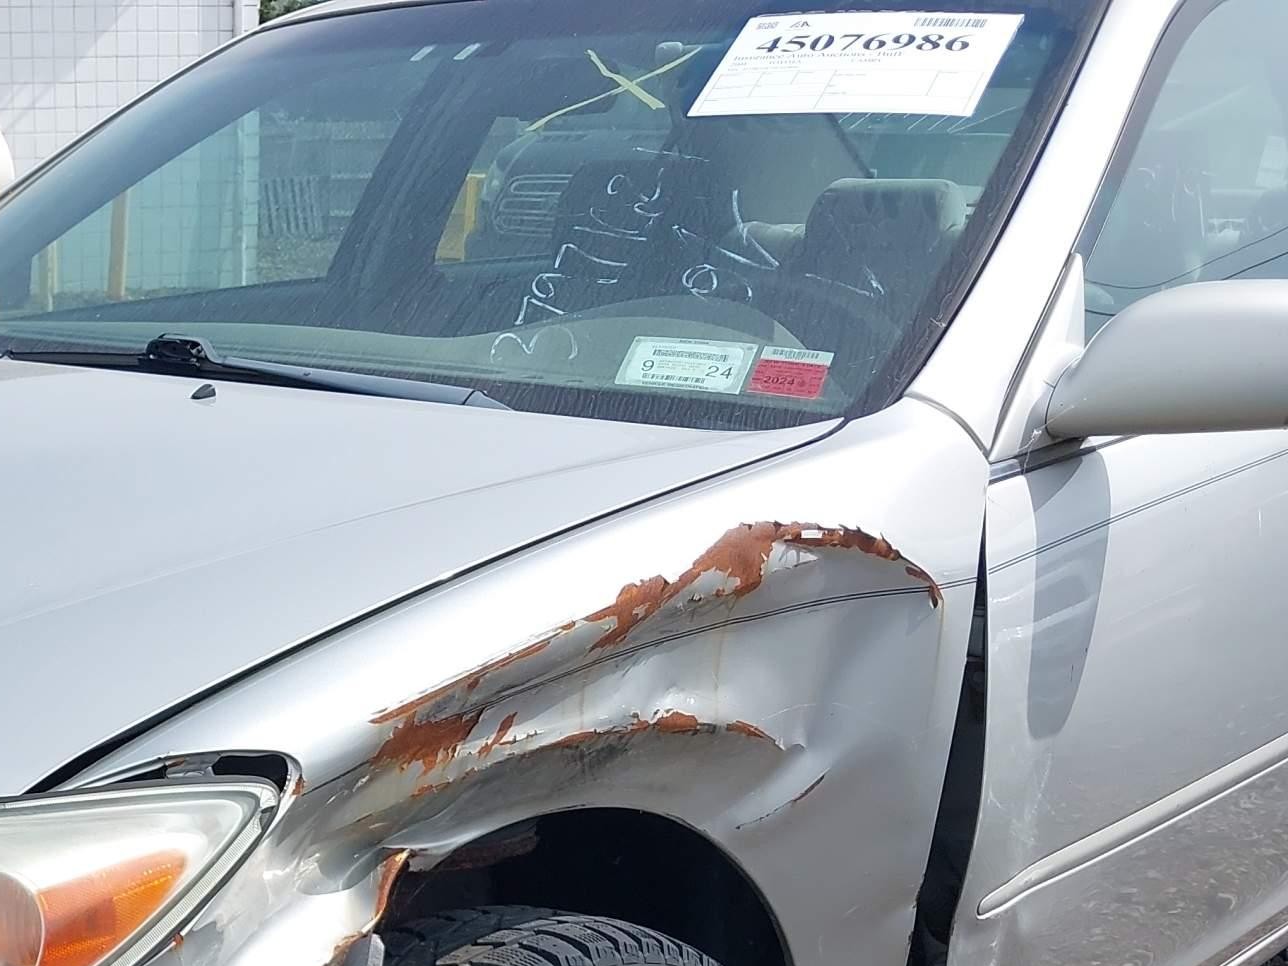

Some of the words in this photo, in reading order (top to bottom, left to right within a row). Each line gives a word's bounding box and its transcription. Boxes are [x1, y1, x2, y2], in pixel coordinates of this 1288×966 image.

[756, 33, 973, 53] 45076986
[640, 359, 655, 372] 9
[705, 365, 733, 380] 24
[763, 375, 796, 387] 2024
